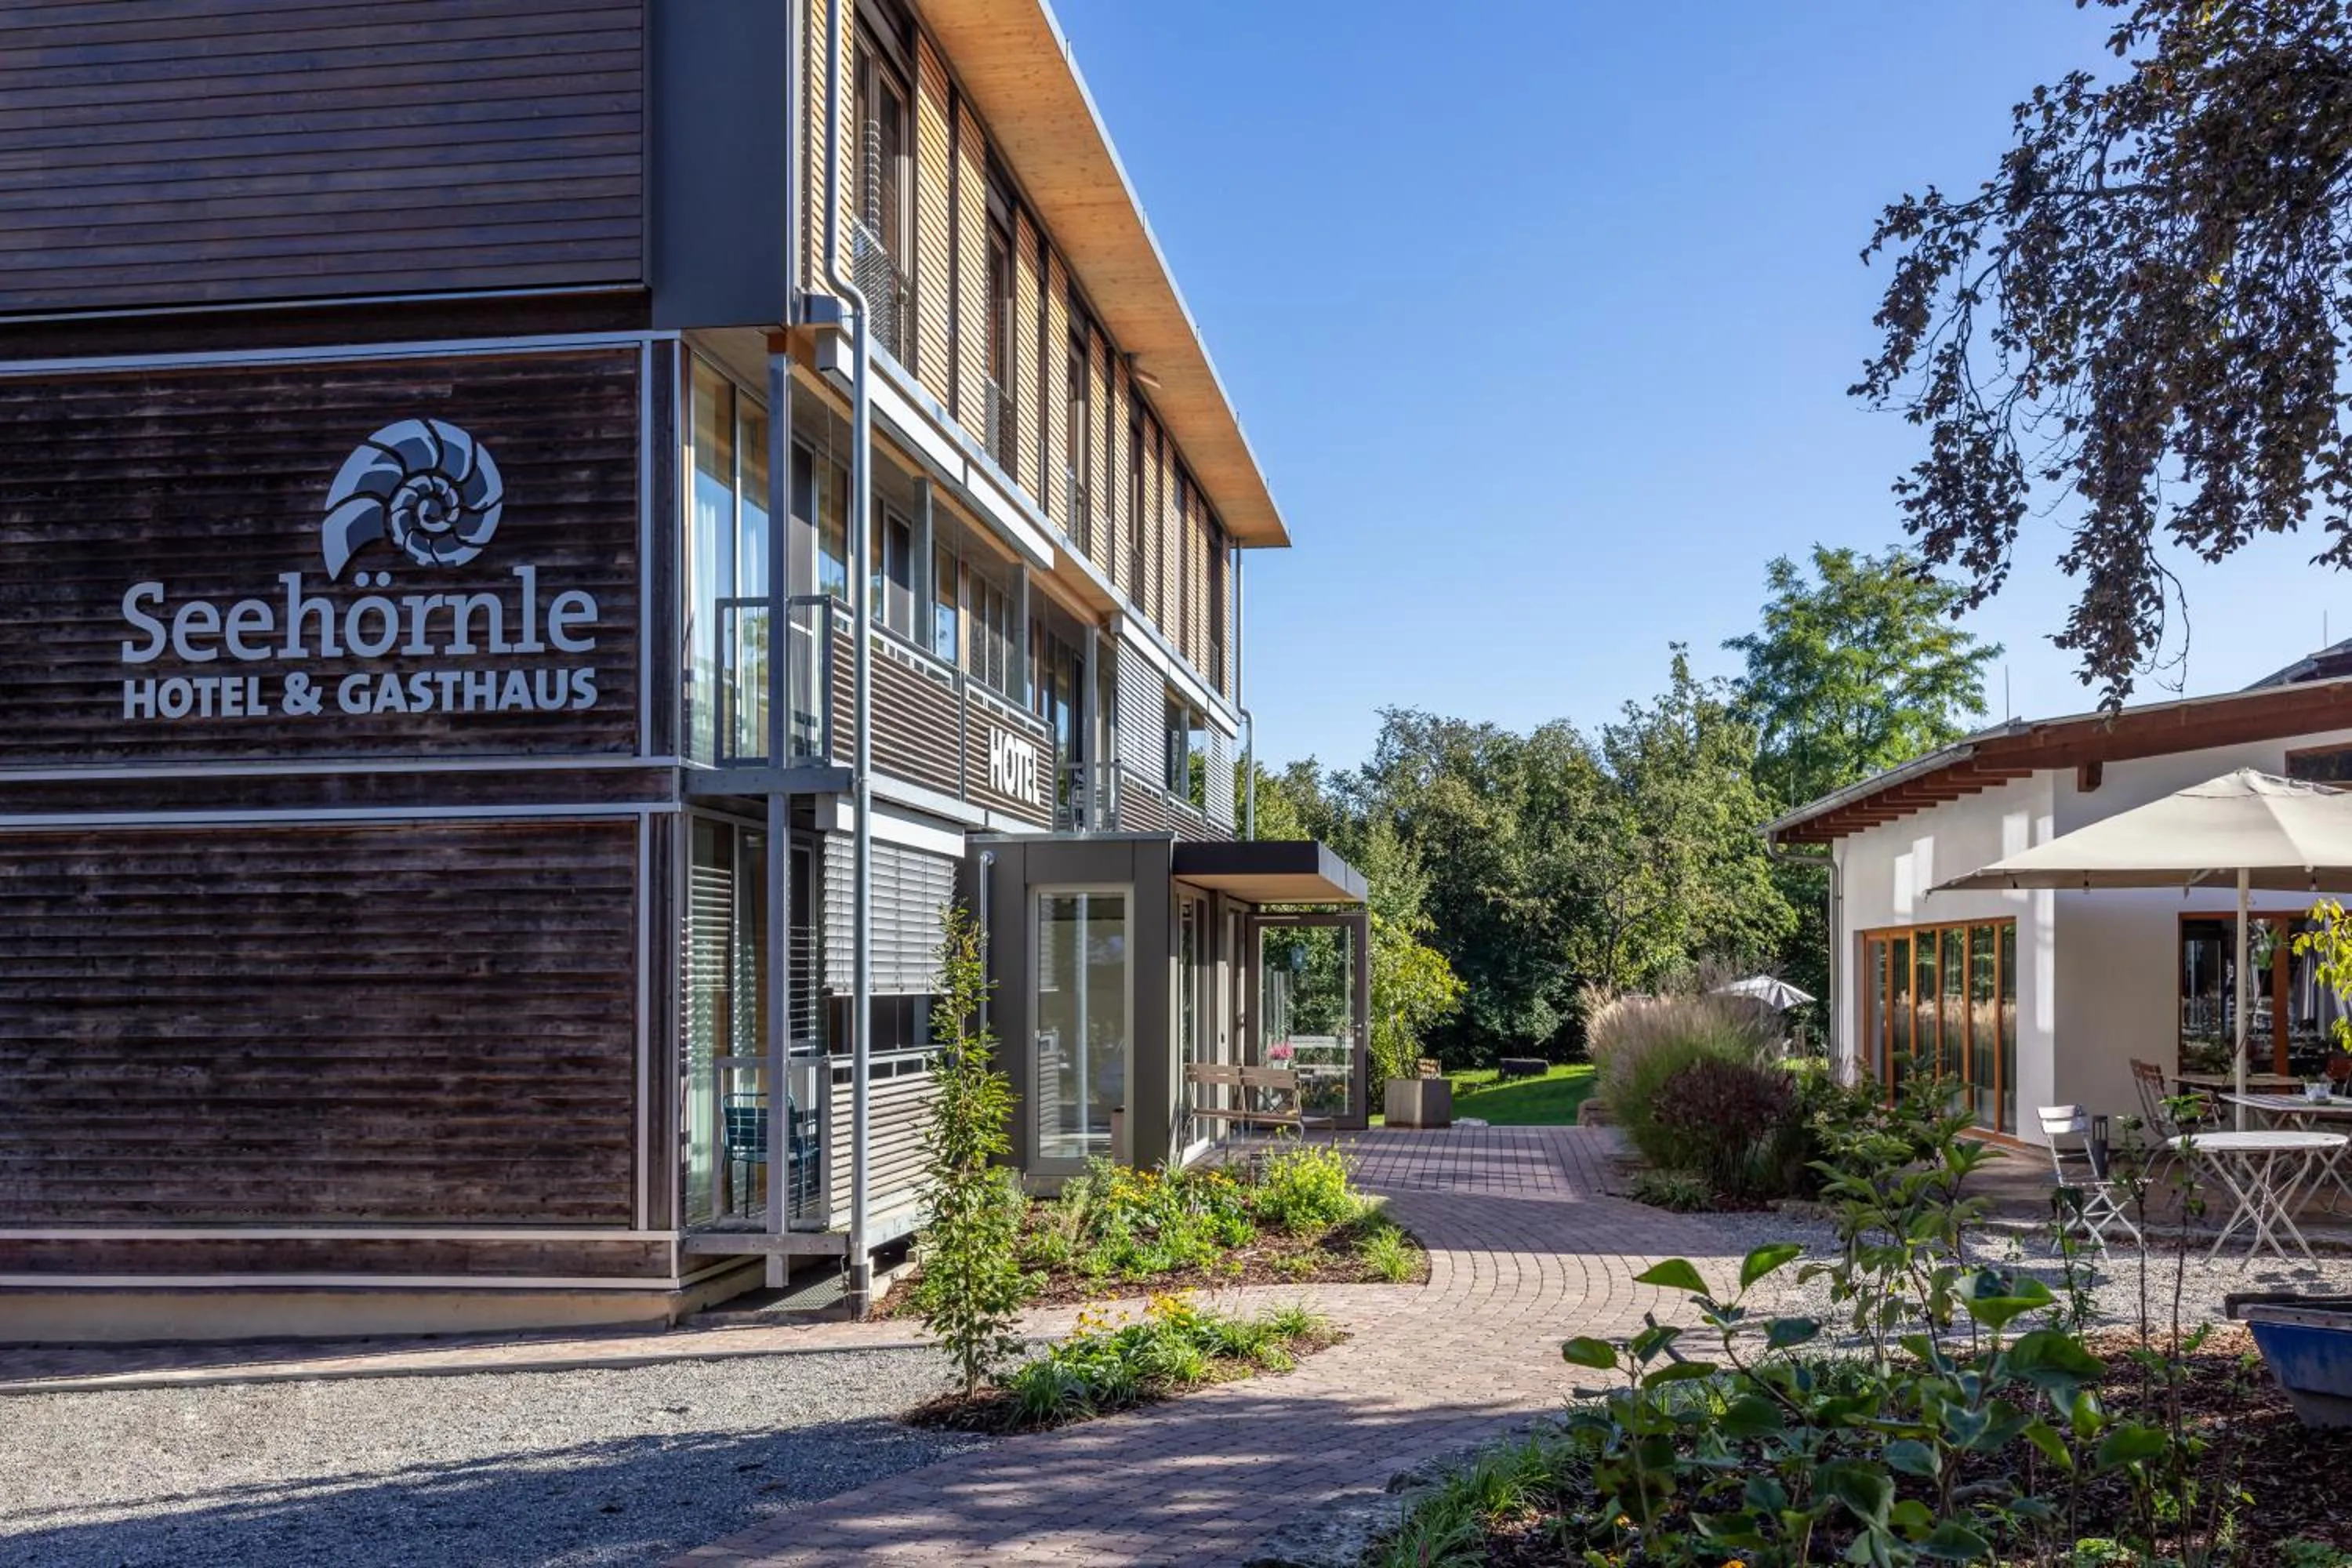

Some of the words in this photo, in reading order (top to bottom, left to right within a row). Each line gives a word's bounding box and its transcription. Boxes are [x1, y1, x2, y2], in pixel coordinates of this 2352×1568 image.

[122, 565, 598, 663] Seehörnle
[122, 677, 268, 719] HOTEL
[281, 671, 323, 716] &
[338, 667, 597, 715] GASTHAUS
[989, 725, 1040, 805] HOTEL
